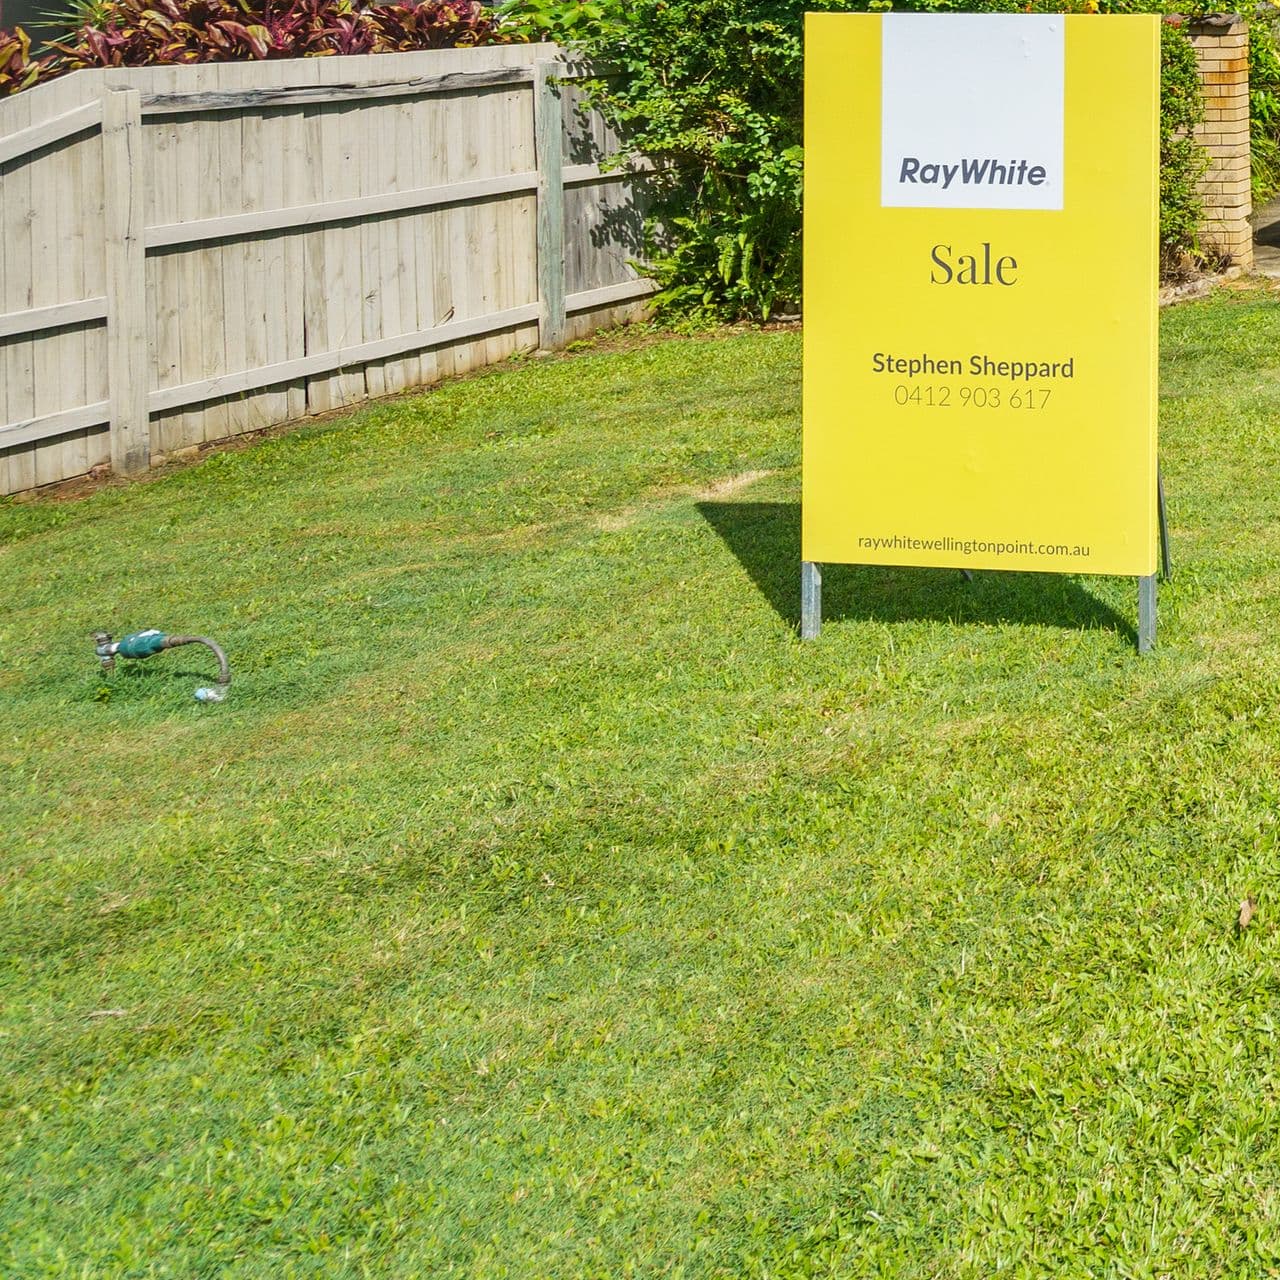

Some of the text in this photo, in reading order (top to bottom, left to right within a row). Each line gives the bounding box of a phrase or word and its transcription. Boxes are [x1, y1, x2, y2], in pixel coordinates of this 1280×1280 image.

[930, 242, 1018, 286] Sale
[872, 352, 1074, 381] Stephen Sheppard
[894, 385, 1052, 409] 0412 903 617
[858, 535, 1090, 557] raywhitewellingtonpoint.com.au
